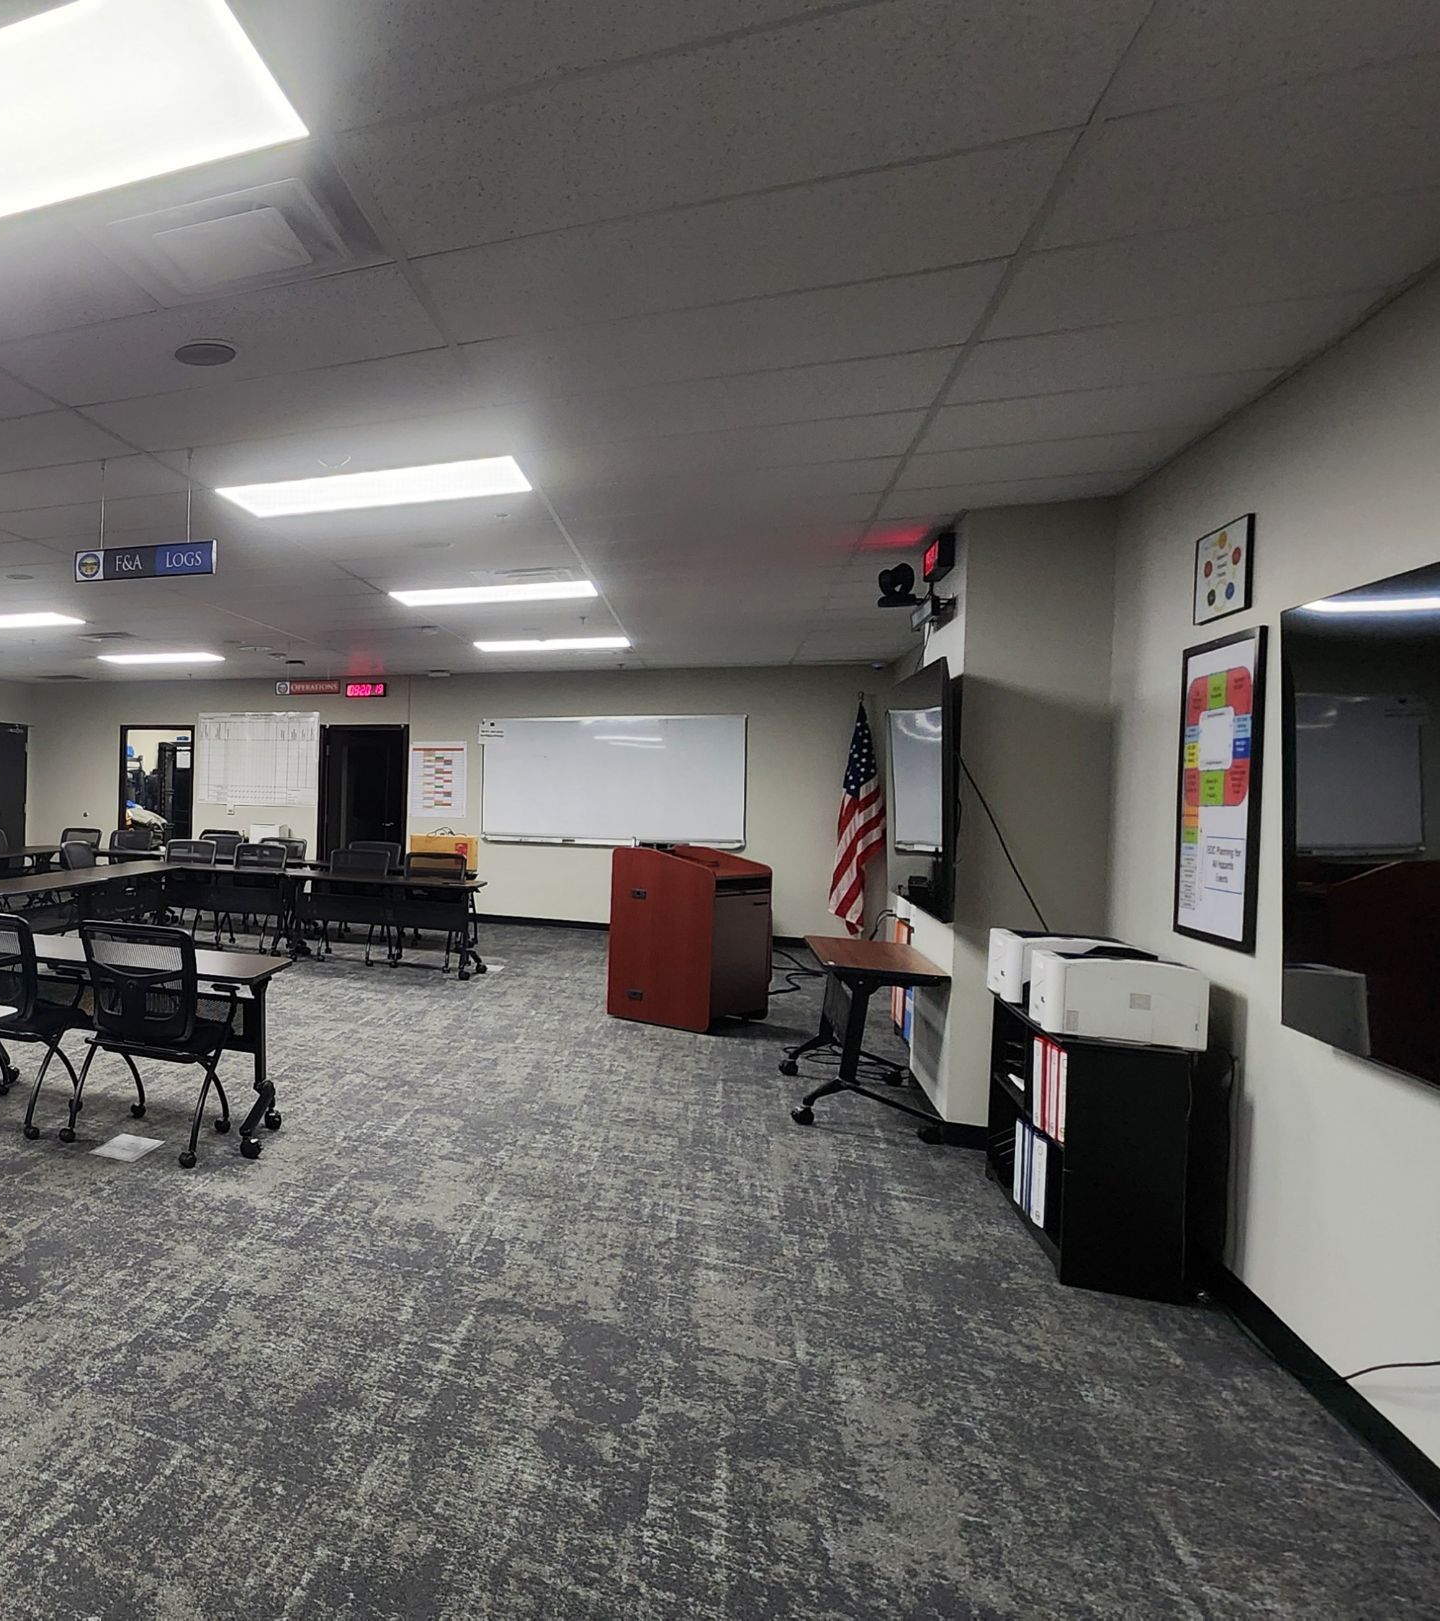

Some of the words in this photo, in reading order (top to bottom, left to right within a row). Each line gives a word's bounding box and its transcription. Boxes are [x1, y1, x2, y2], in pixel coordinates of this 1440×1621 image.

[115, 554, 142, 571] F&A
[165, 551, 202, 568] LOGS
[290, 682, 338, 692] OPERATIONS
